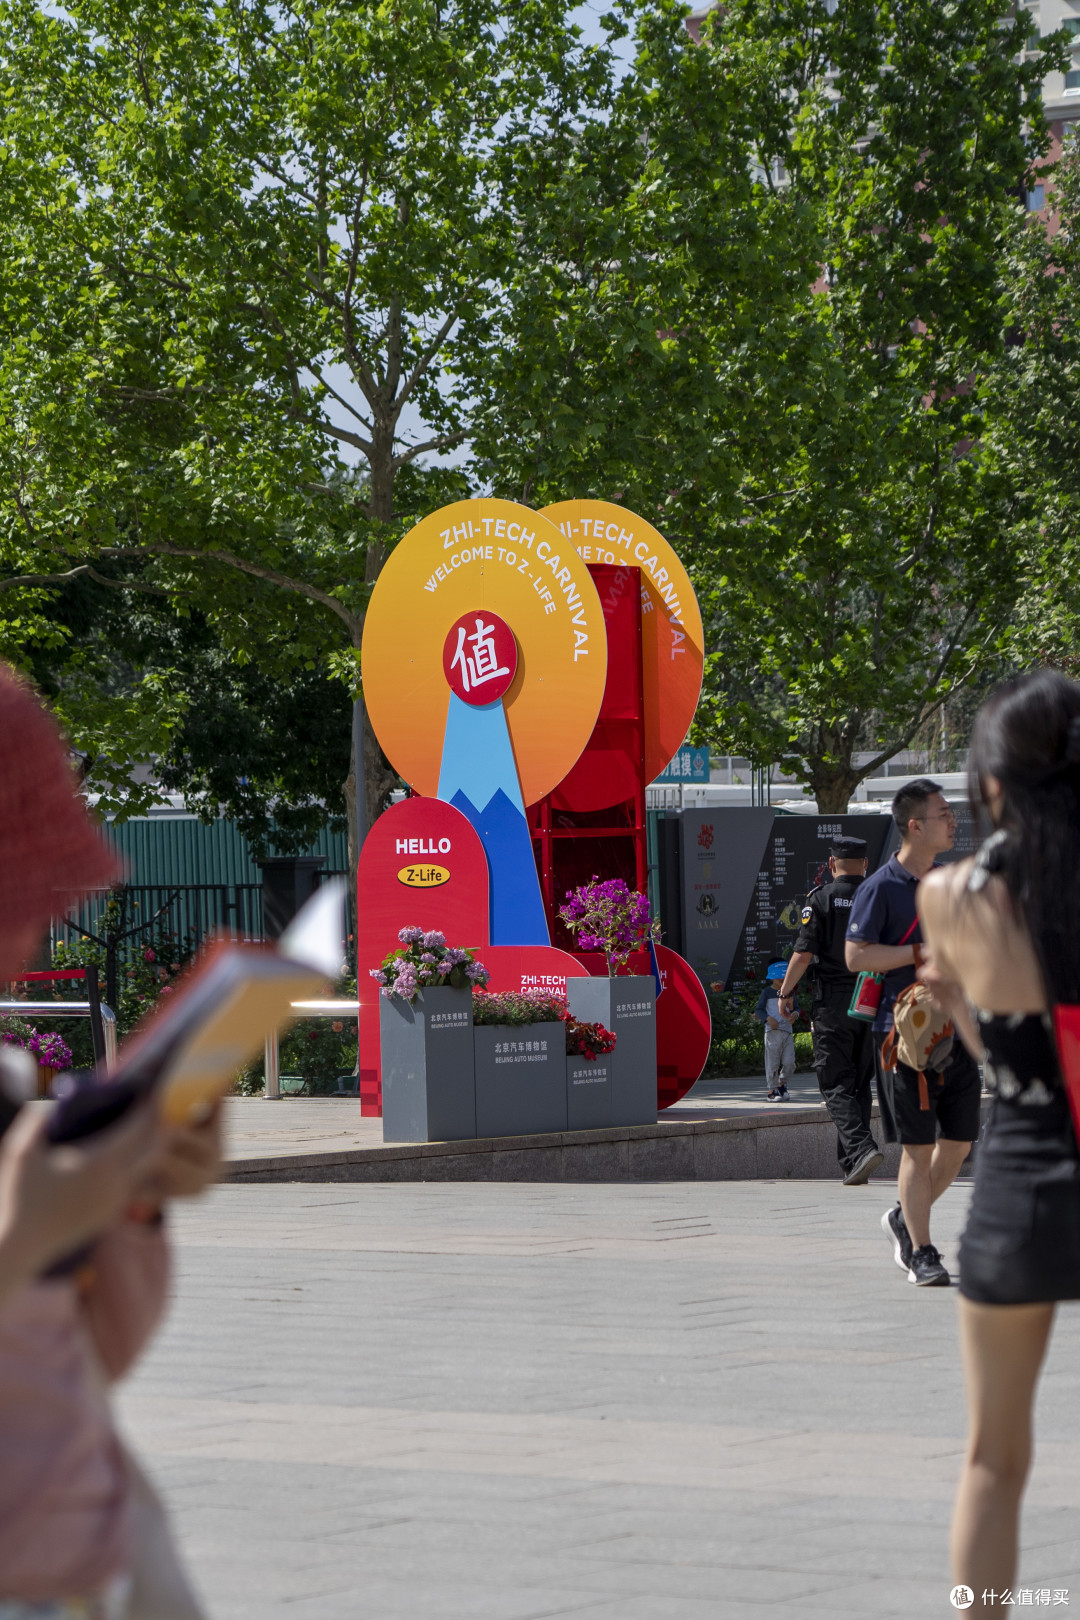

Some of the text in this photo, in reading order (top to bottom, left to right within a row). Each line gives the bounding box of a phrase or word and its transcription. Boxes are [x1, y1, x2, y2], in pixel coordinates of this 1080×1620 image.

[595, 547, 615, 565] TO
[424, 546, 493, 593] WELCOME
[497, 547, 517, 566] TO
[439, 518, 536, 549] ZHI-TECH
[536, 541, 589, 662] CARNIVAL
[634, 542, 686, 661] CARNIVAL
[450, 618, 510, 692] 值
[396, 837, 451, 854] HELLO
[406, 868, 442, 882] Z-Life
[520, 975, 566, 985] ZHI-TECH
[494, 1040, 548, 1053] 北京汽车博物馆
[495, 1056, 514, 1064] BEIJING
